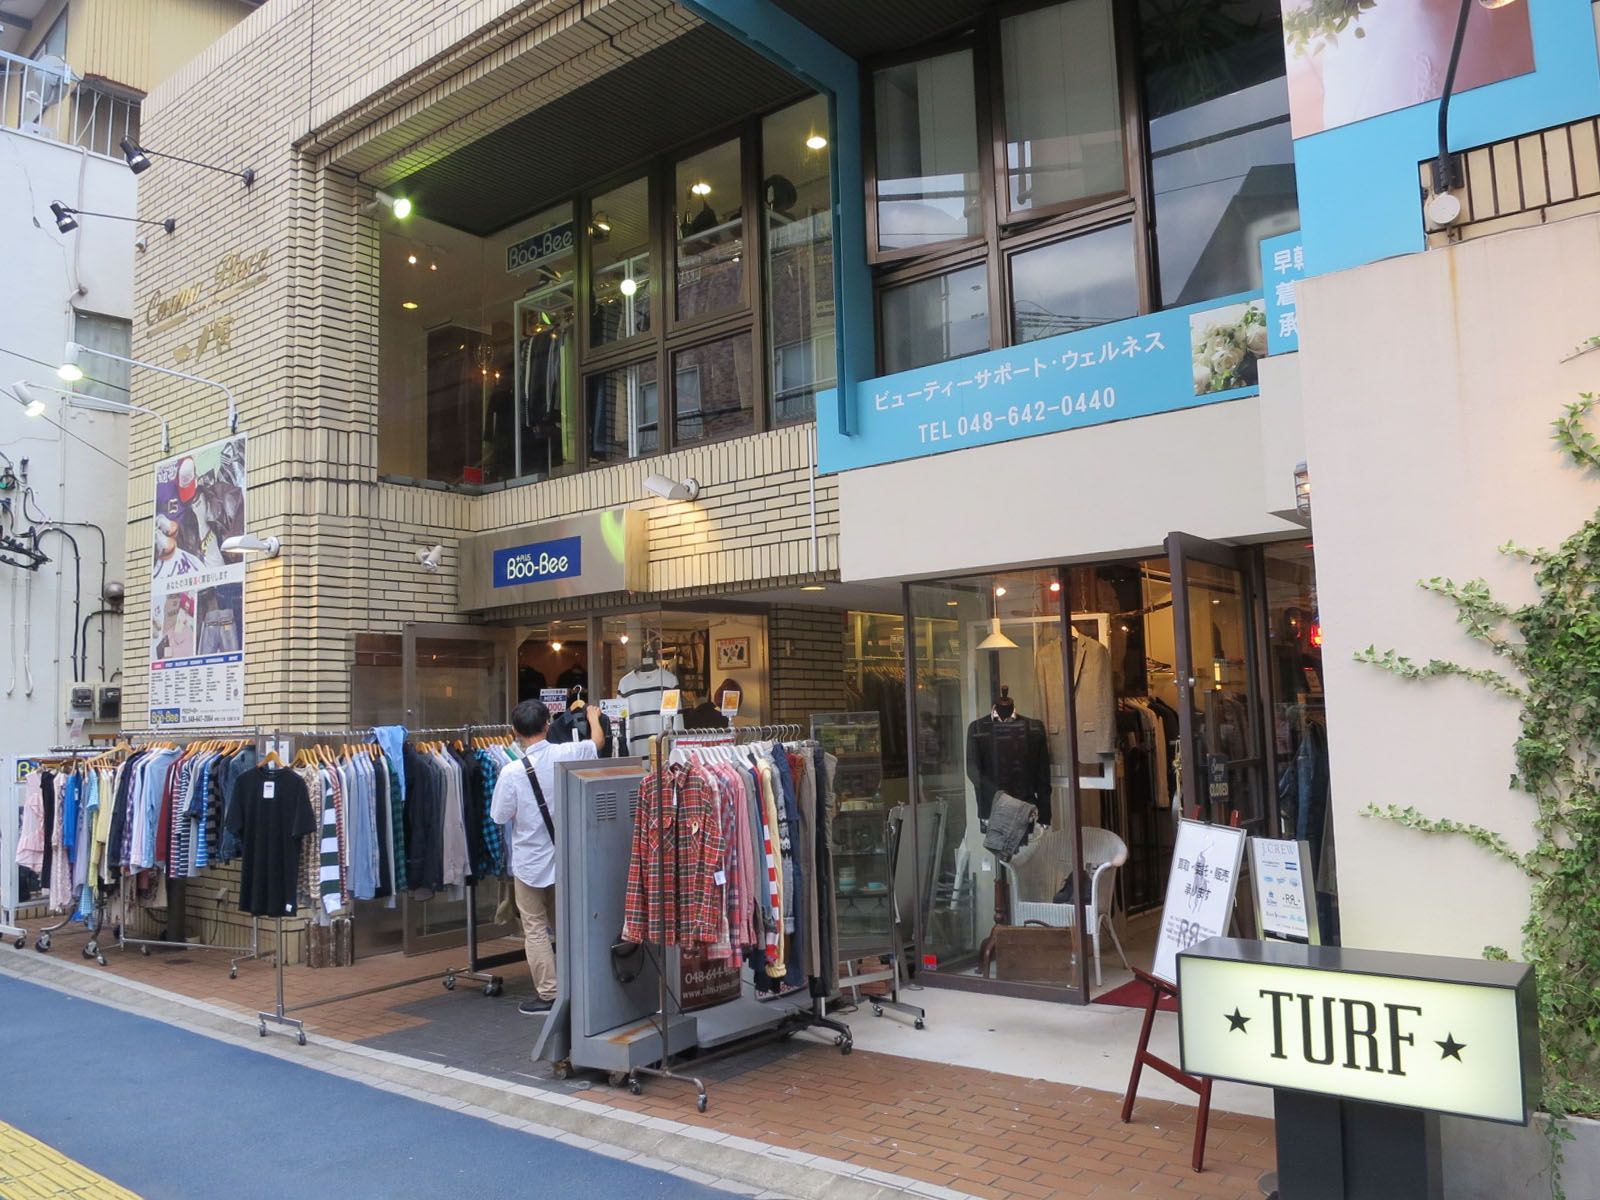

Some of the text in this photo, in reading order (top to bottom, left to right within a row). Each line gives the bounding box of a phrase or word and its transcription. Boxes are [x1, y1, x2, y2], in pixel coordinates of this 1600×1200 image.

[509, 231, 573, 269] Boo-Bee
[874, 331, 1166, 412] ビューティーサポート・ウェルネス
[918, 386, 1116, 444] TEL 048-642-0440
[507, 553, 568, 580] Boo-Bee
[1259, 989, 1422, 1076] TURF
